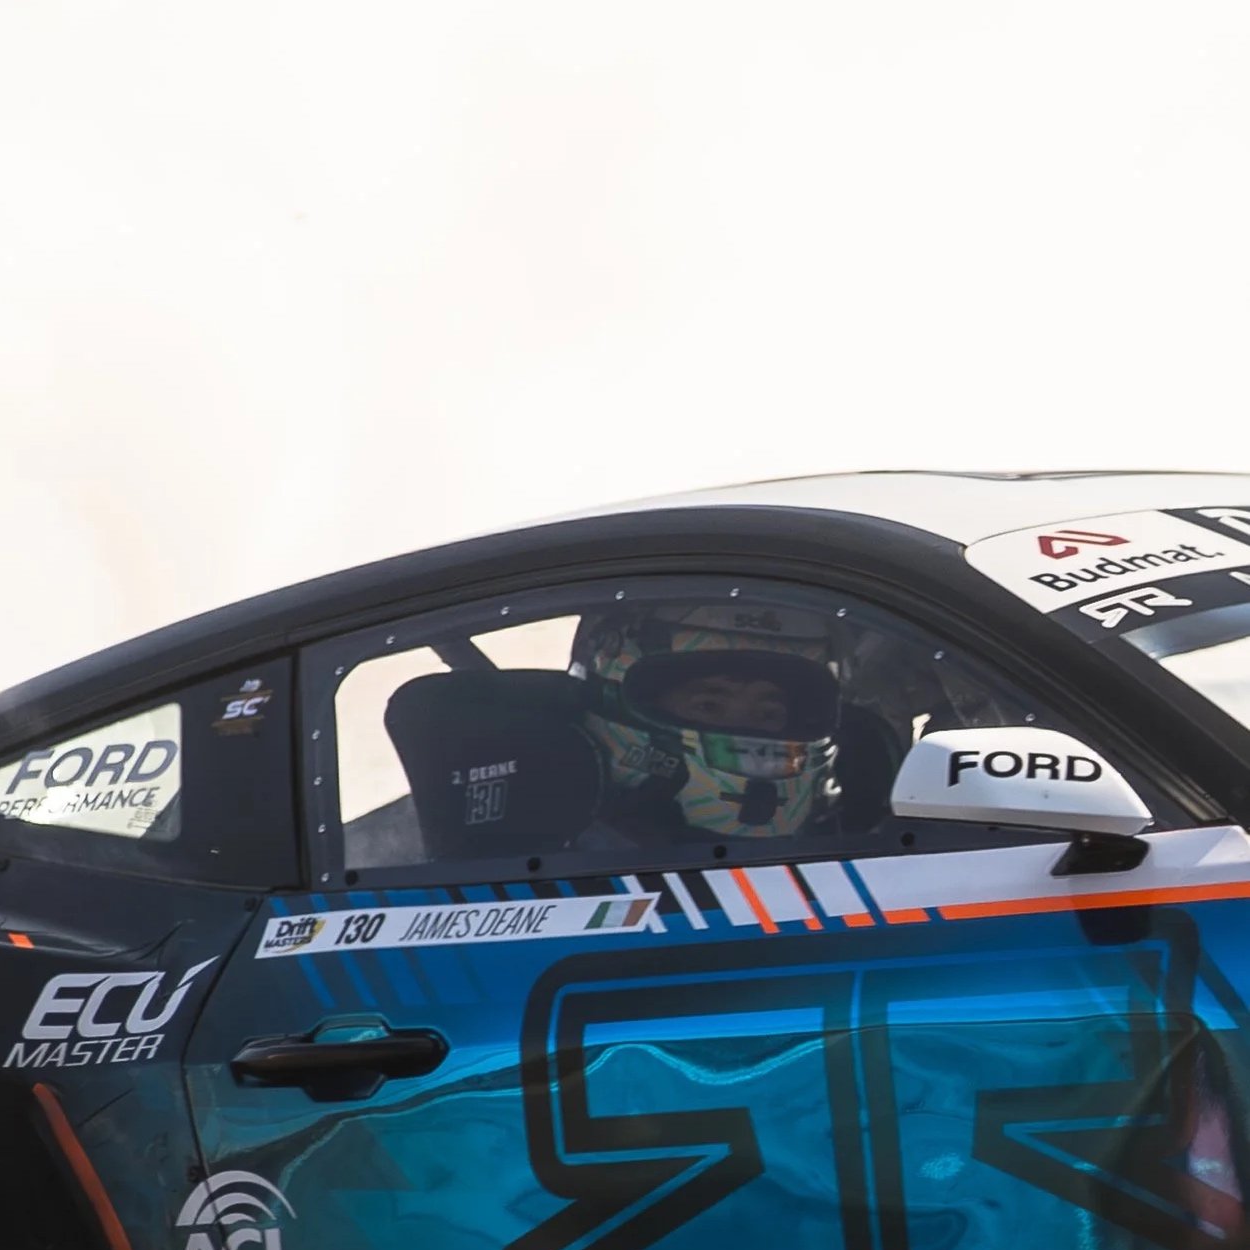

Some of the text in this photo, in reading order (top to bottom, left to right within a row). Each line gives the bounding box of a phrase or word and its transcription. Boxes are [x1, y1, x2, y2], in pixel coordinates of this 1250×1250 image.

[6, 740, 179, 794] FORD
[948, 751, 1102, 787] FORD
[276, 916, 317, 938] Drift
[334, 904, 557, 945] 130 JAMES DEANE
[22, 955, 221, 1040] ECU
[2, 1024, 165, 1068] MASTER
